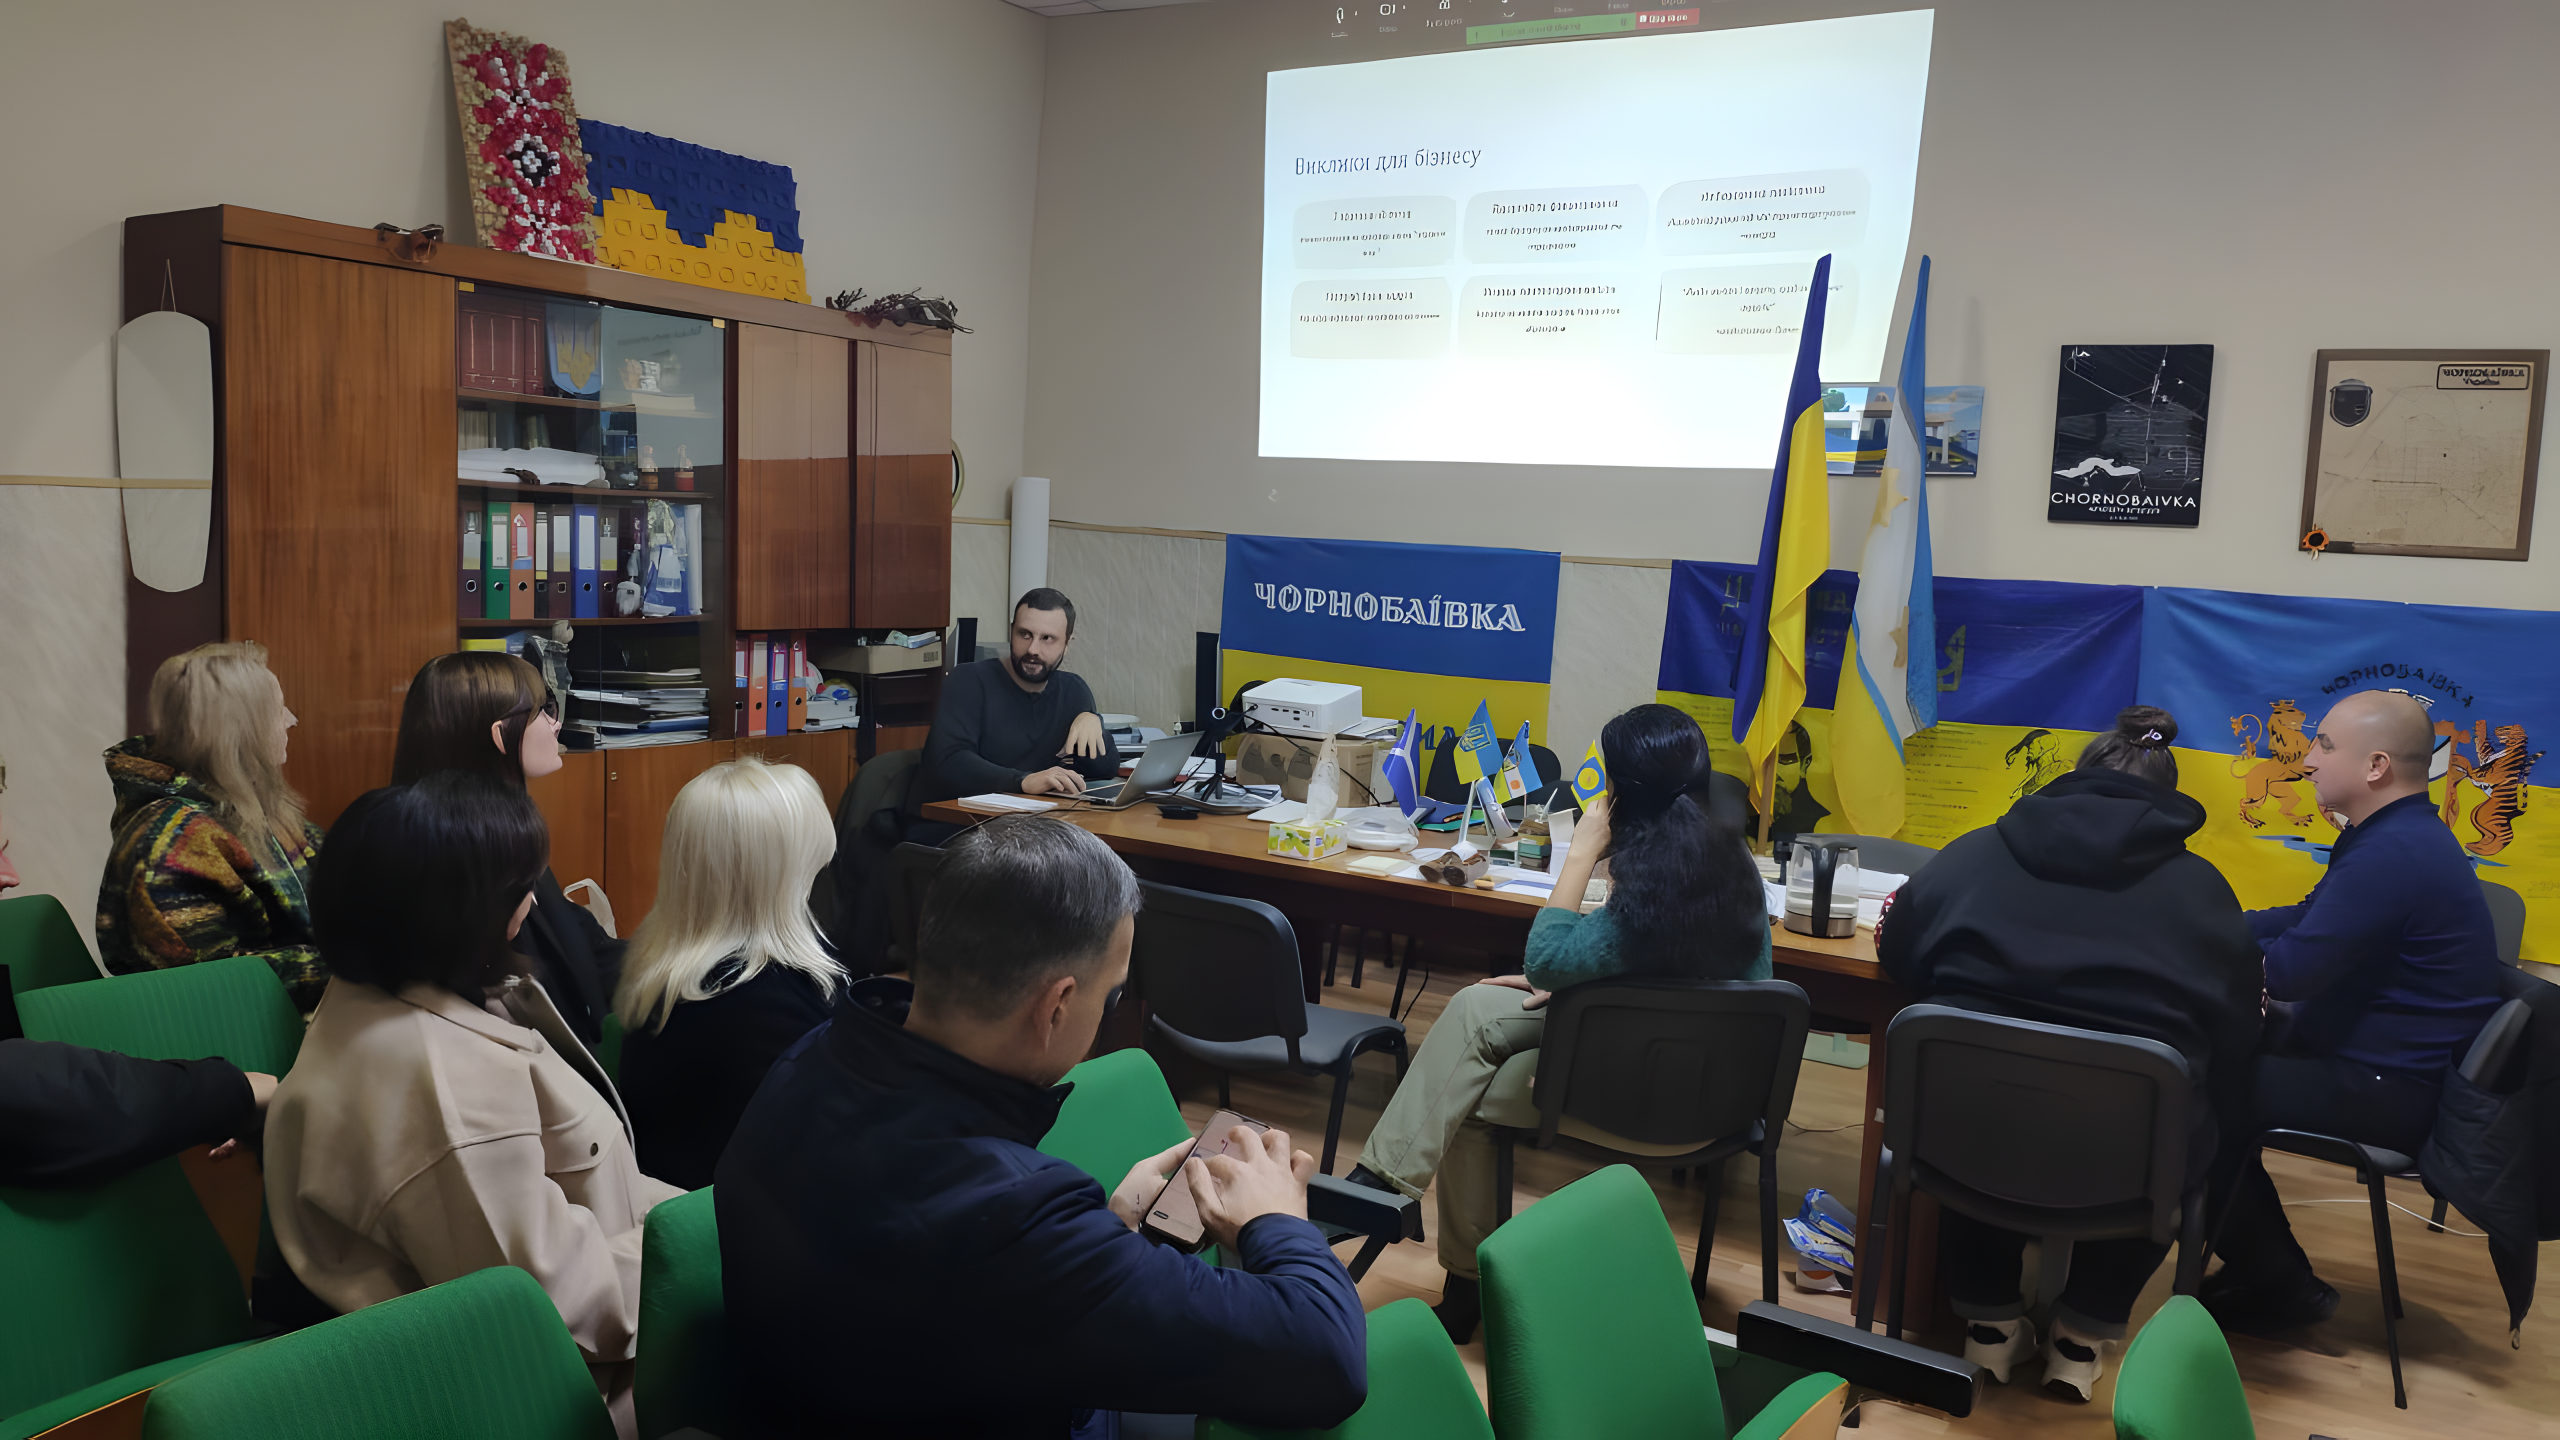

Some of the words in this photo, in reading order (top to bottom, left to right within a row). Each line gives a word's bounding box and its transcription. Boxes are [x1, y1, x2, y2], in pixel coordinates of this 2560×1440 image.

[1375, 154, 1408, 173] для
[1415, 148, 1482, 168] бізнесу
[2051, 492, 2196, 508] CHORNOBAIVKA
[1254, 582, 1526, 632] ЧОРНОБАЇВКА
